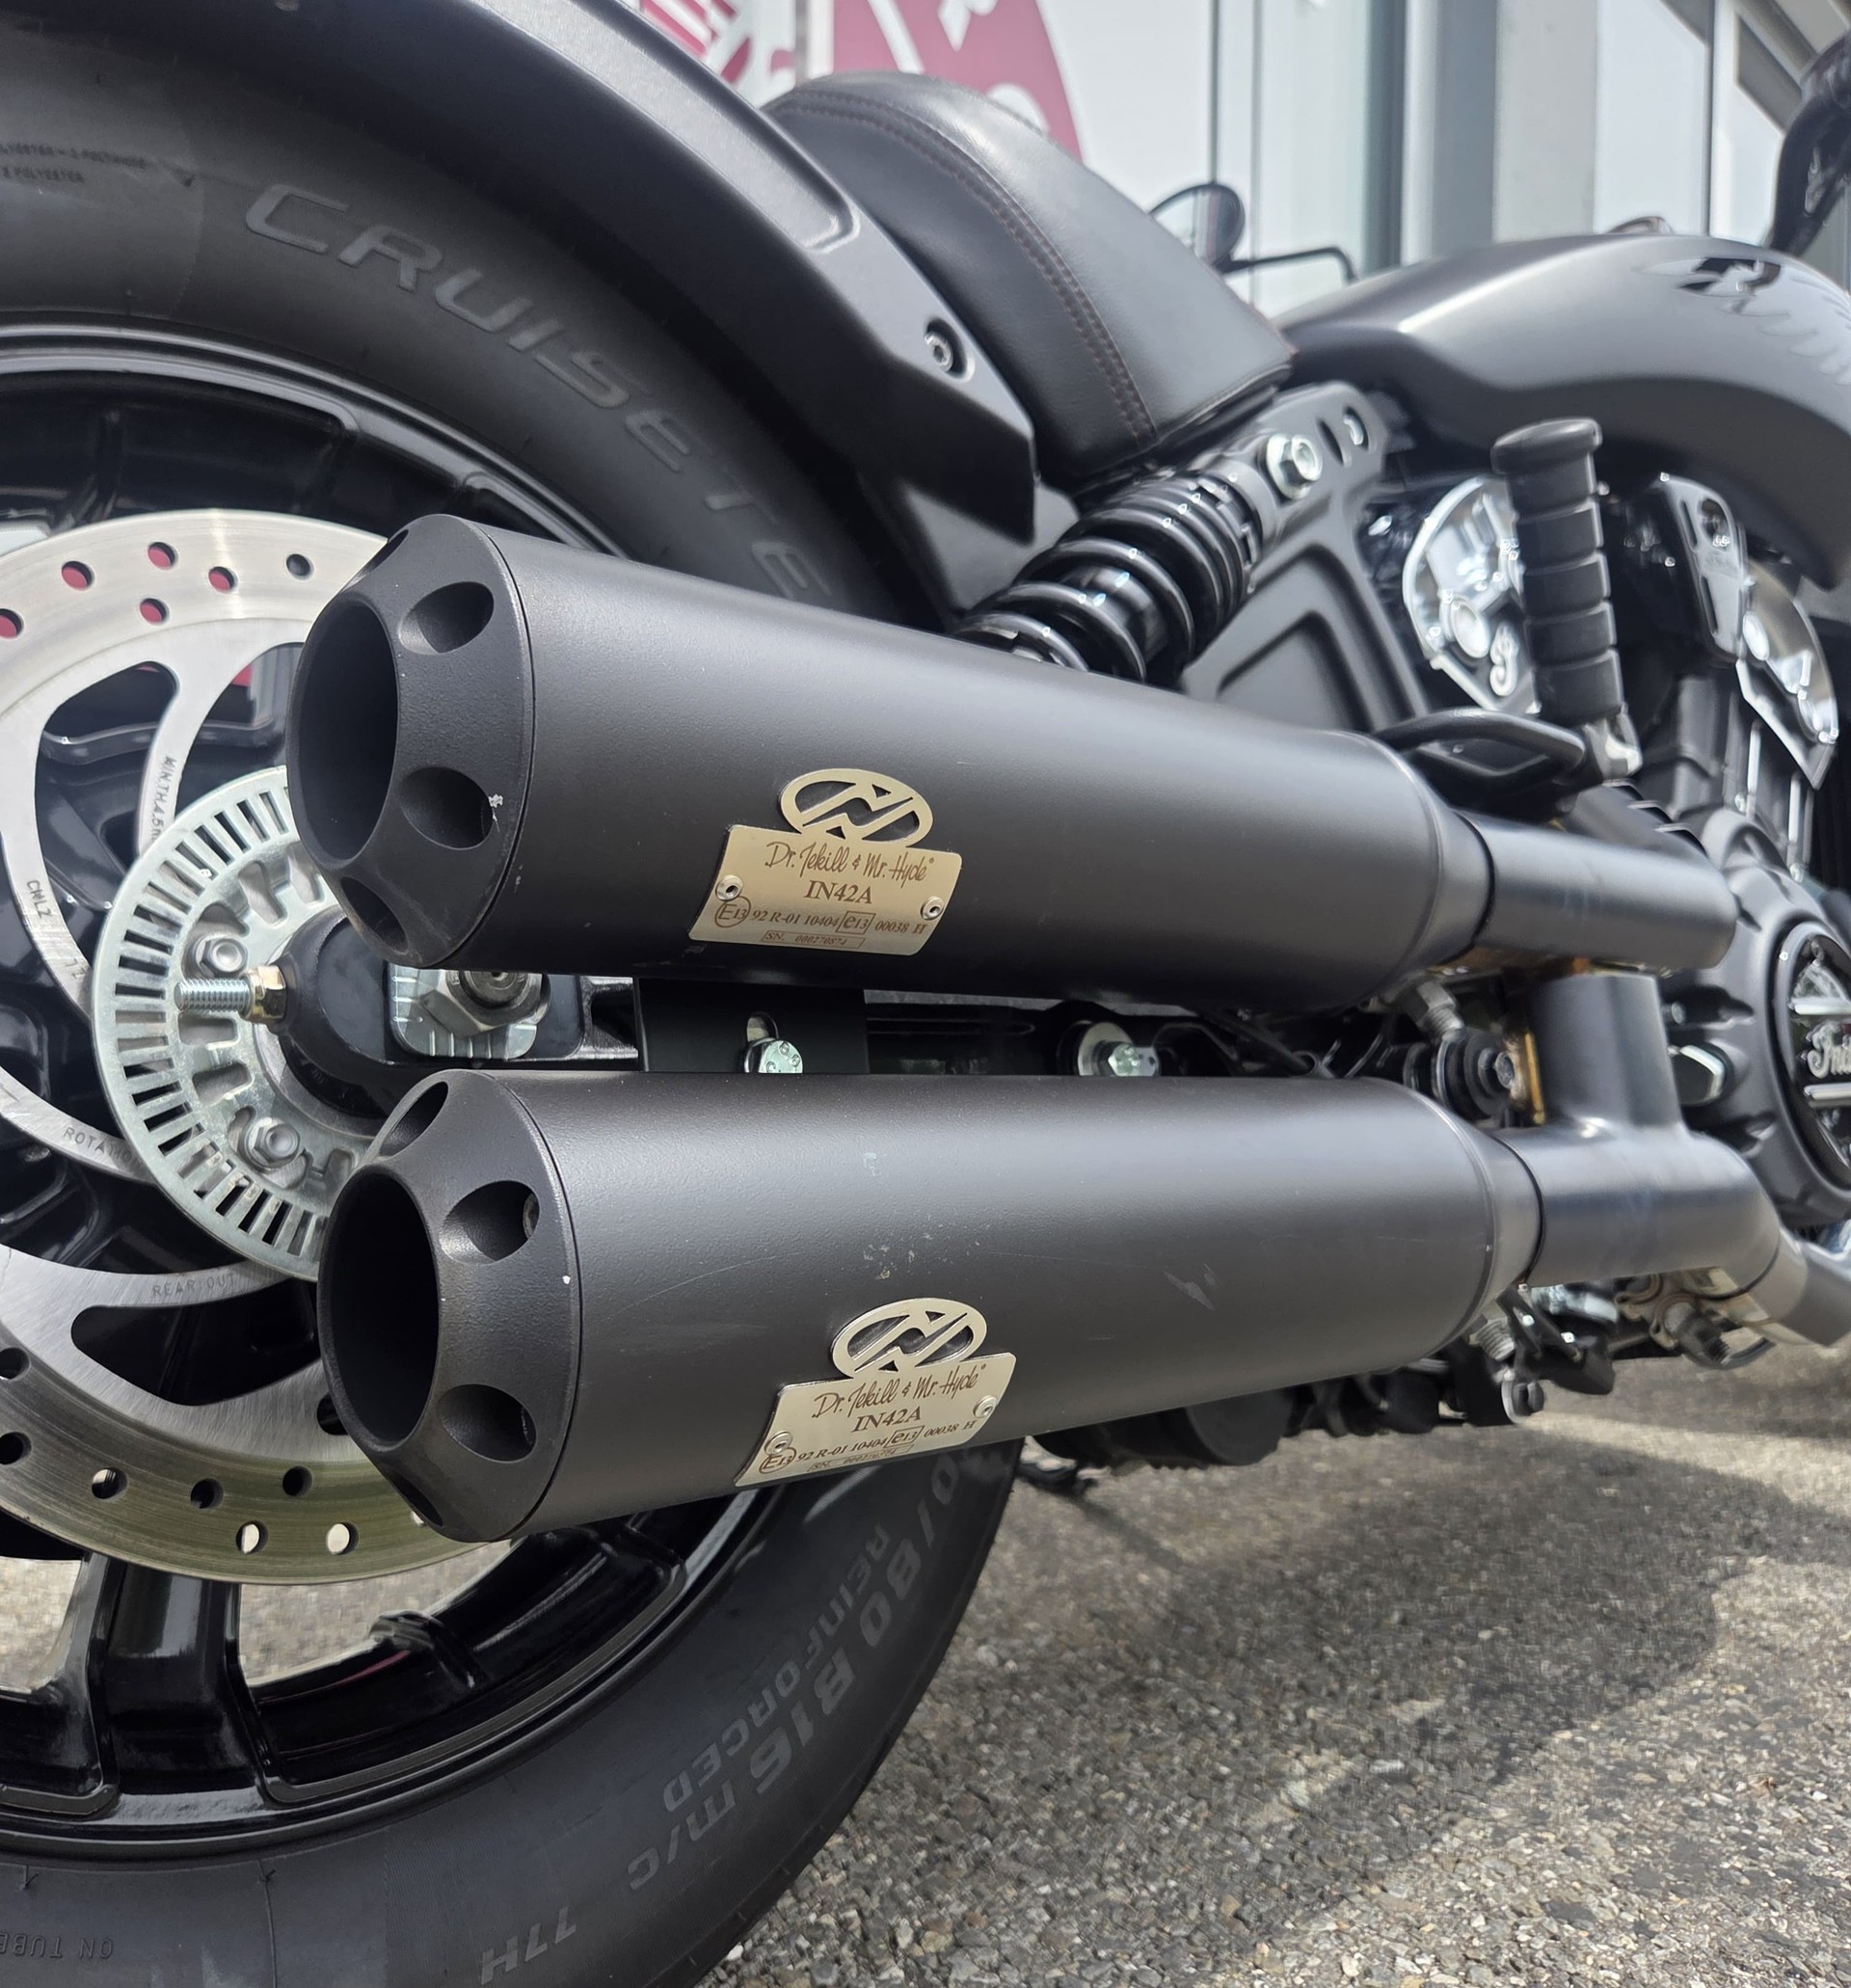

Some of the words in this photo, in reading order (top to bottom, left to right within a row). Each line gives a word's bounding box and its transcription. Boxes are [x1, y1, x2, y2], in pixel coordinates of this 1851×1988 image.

[765, 841, 795, 869] Dr.
[799, 841, 850, 878] Jekill
[863, 852, 887, 879] Mr.
[804, 879, 872, 904] IN42A
[752, 910, 768, 922] 92
[769, 911, 799, 925] R-01
[803, 915, 839, 927] 10404
[874, 920, 910, 934] 00038
[913, 923, 929, 935] H
[812, 1391, 845, 1418] Dr.
[847, 1378, 900, 1417] Jekill
[912, 1374, 936, 1400] Mr.
[851, 1406, 922, 1433] IN42A
[796, 1451, 815, 1463] 92
[816, 1444, 847, 1460] R-01
[924, 1422, 960, 1437] 00038
[749, 1647, 856, 1797] B16
[79, 1937, 114, 1960] ON
[480, 1905, 577, 1987] 77H
